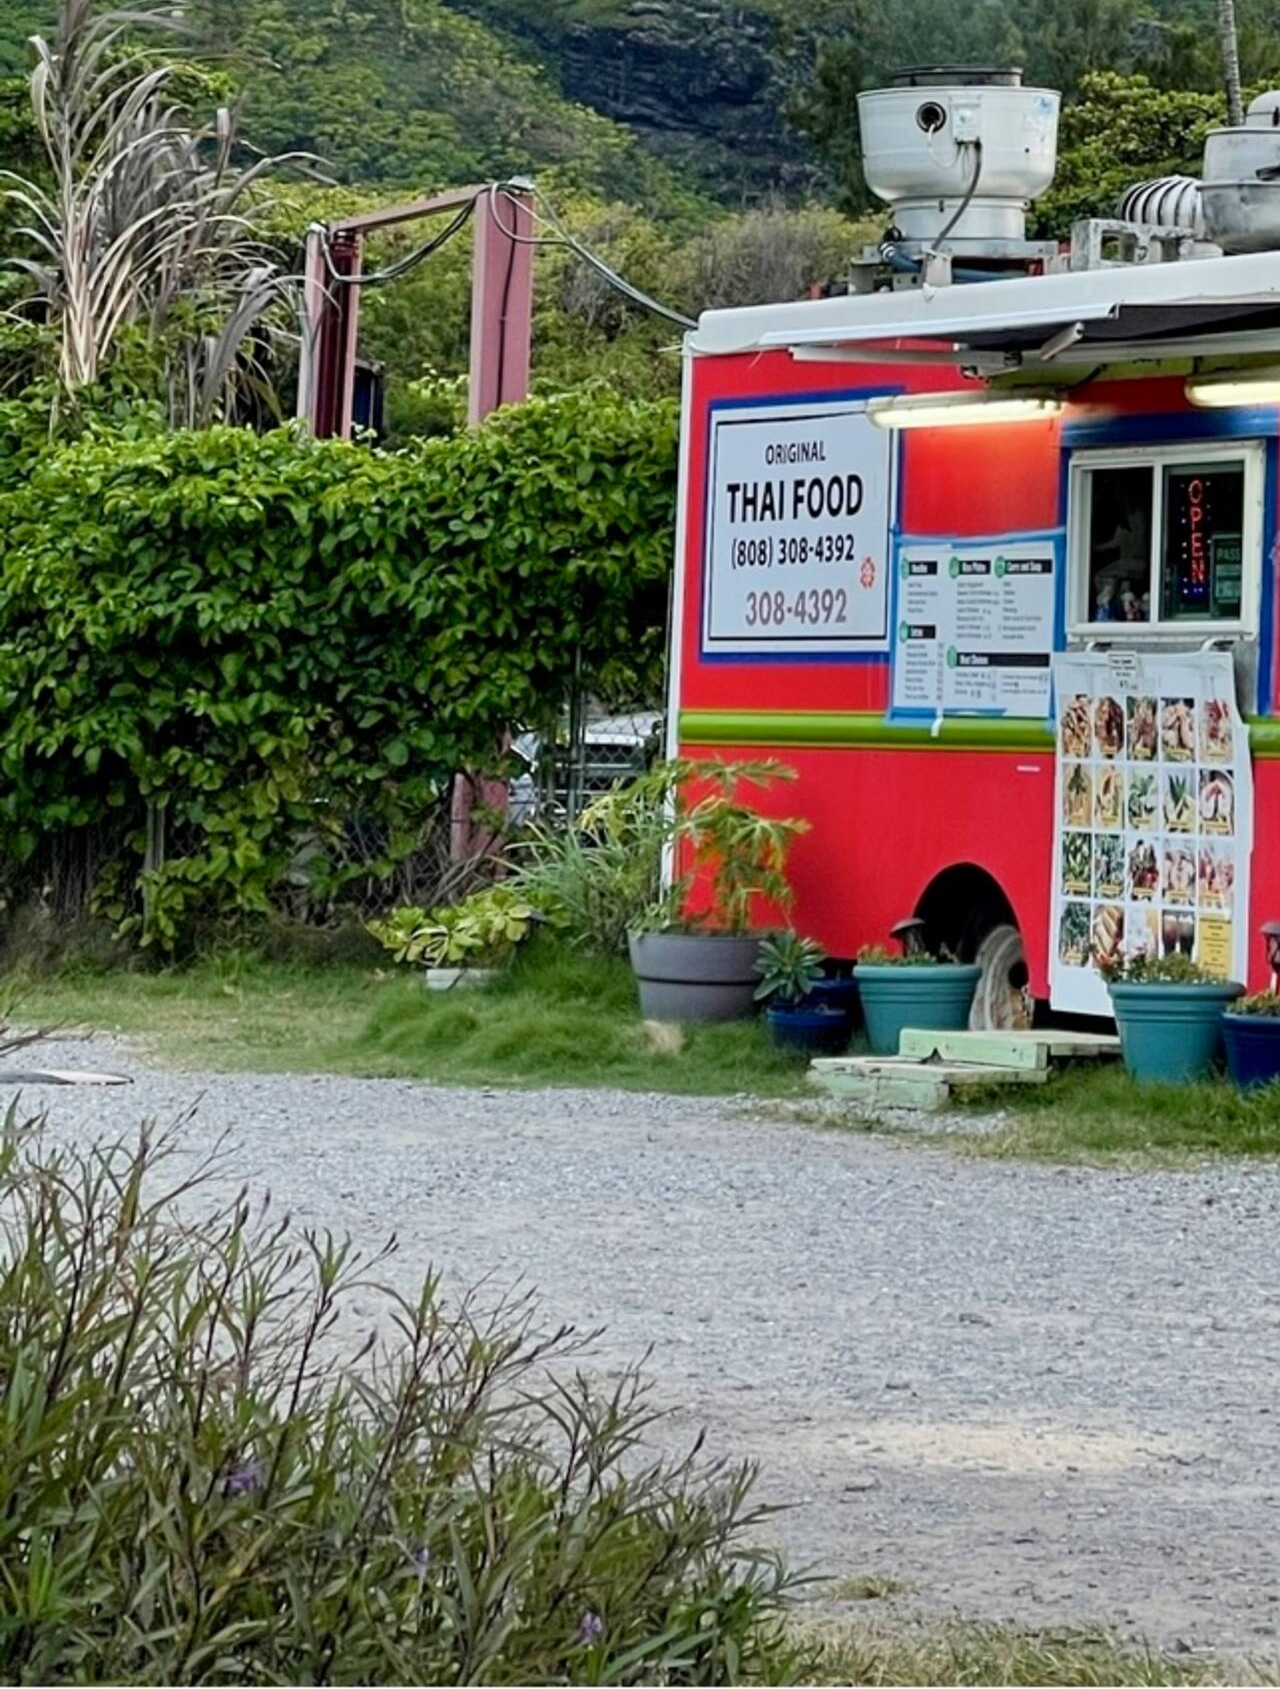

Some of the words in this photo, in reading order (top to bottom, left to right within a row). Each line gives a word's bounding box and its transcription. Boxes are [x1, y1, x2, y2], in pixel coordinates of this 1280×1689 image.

[765, 441, 826, 465] ORIGINAL
[727, 480, 785, 523] THAI
[792, 474, 863, 519] FOOD
[1188, 479, 1205, 584] OPEN
[731, 536, 773, 569] (808)
[777, 533, 855, 565] 308-4392
[745, 588, 848, 626] 308-4392
